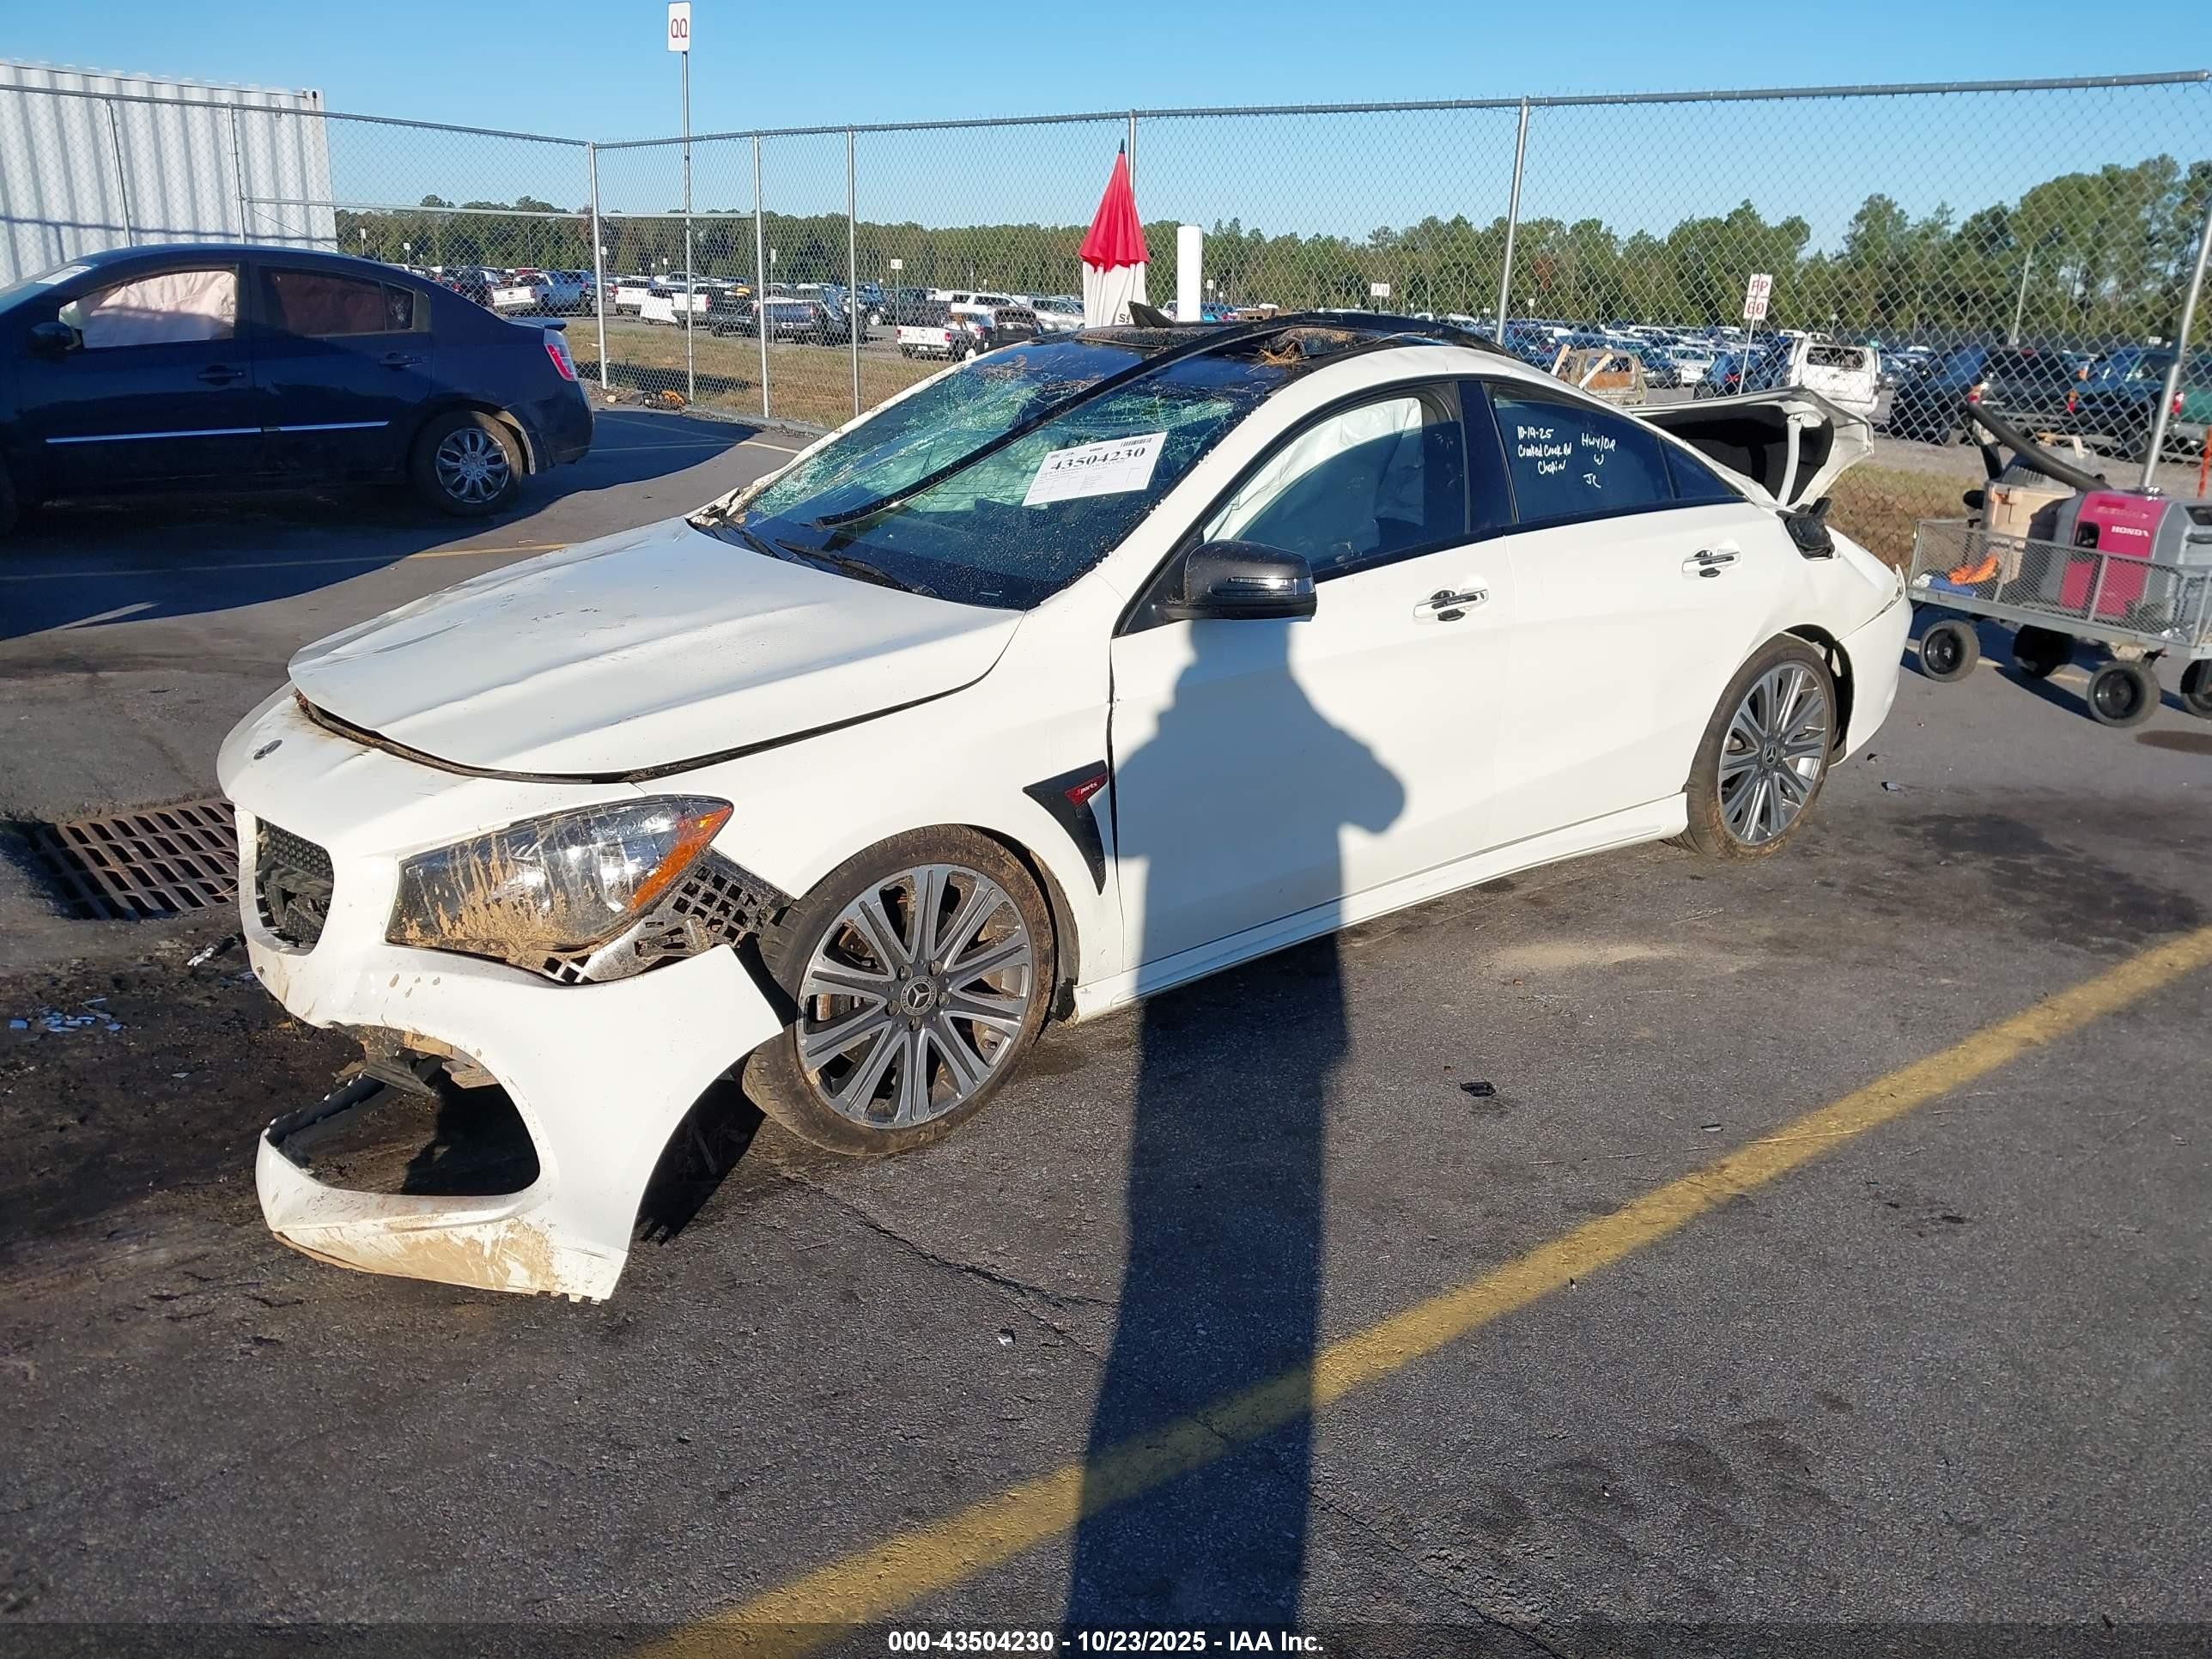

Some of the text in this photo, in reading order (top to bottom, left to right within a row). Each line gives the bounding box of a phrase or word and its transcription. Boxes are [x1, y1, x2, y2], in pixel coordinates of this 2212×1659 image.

[671, 18, 688, 39] QQ
[1517, 425, 1554, 441] 10-19-25
[1050, 447, 1146, 471] 43504230
